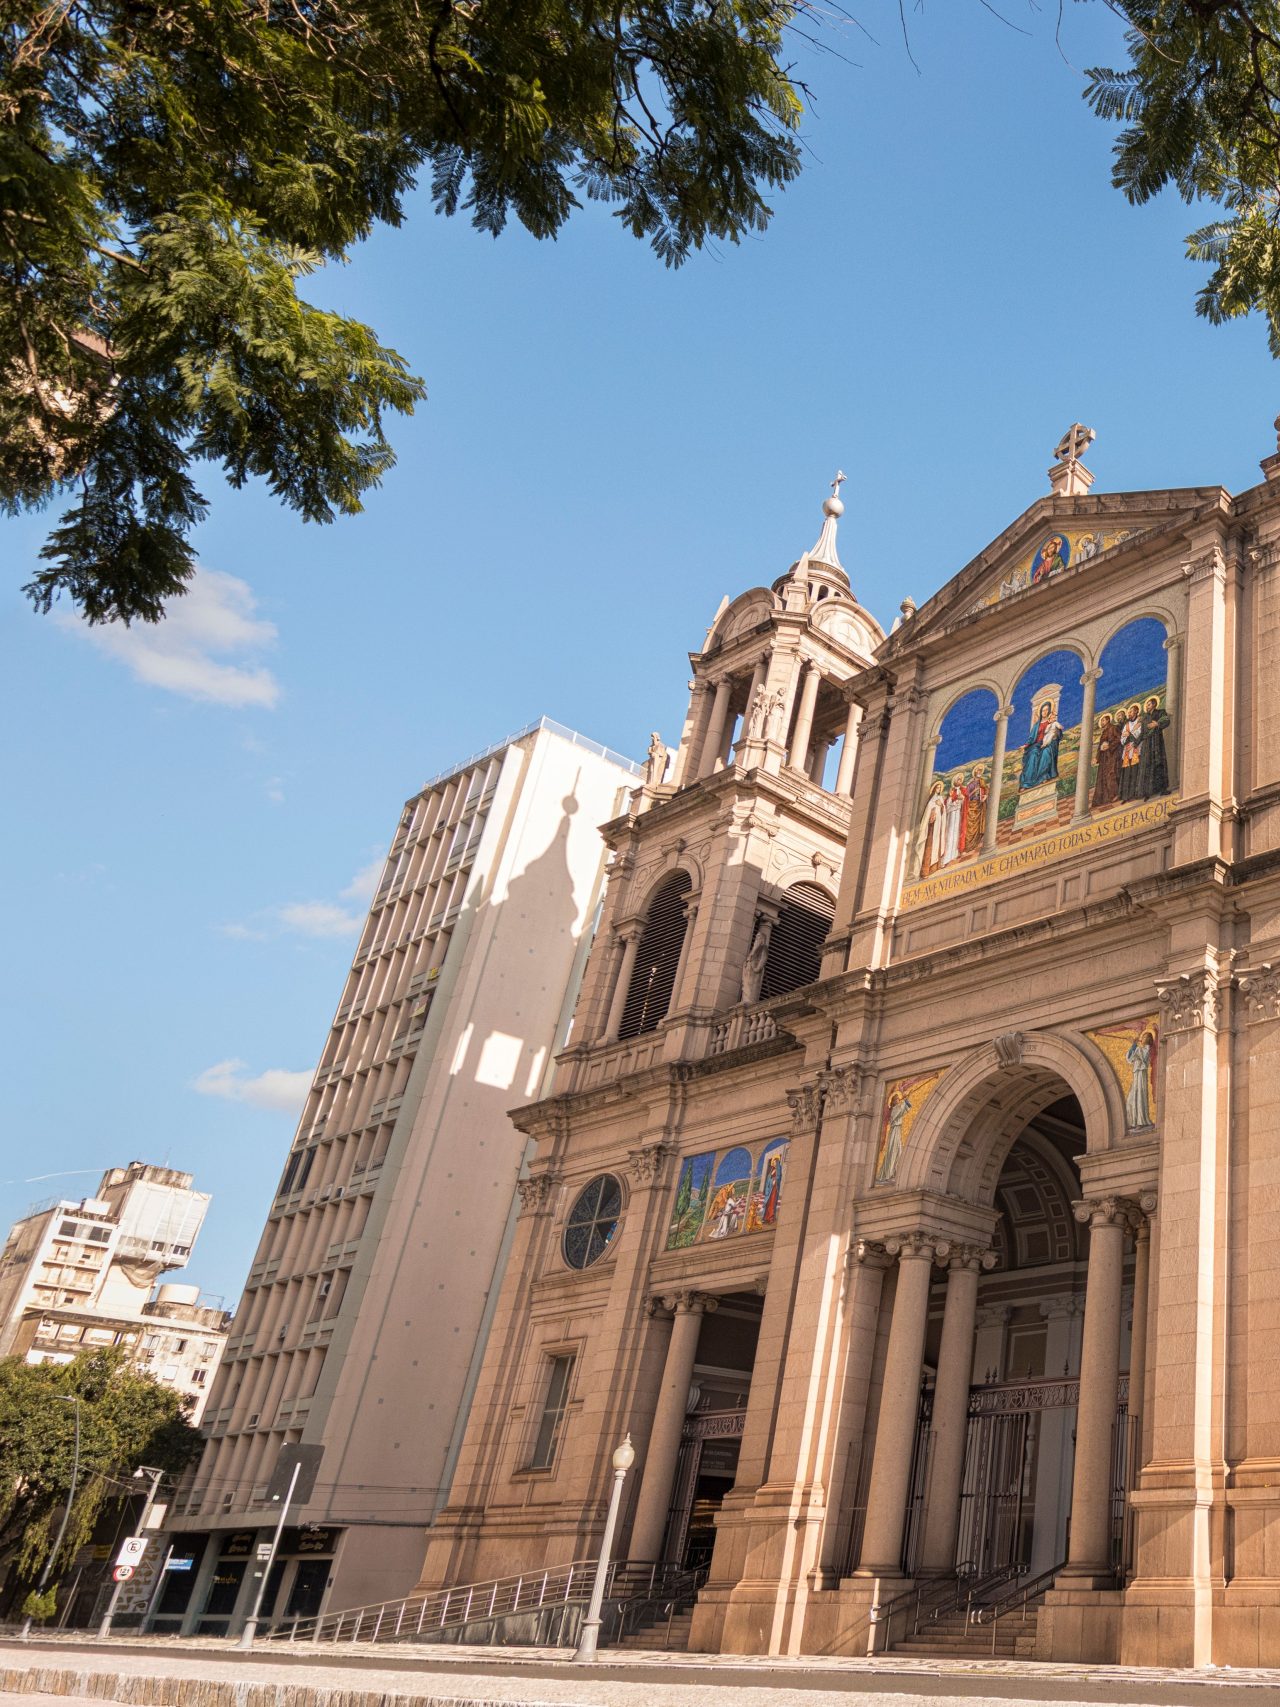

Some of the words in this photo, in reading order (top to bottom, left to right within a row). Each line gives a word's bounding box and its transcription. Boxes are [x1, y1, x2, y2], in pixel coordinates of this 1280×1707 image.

[981, 864, 996, 878] ME
[1059, 828, 1092, 852] TODAS
[1095, 822, 1110, 837] AS
